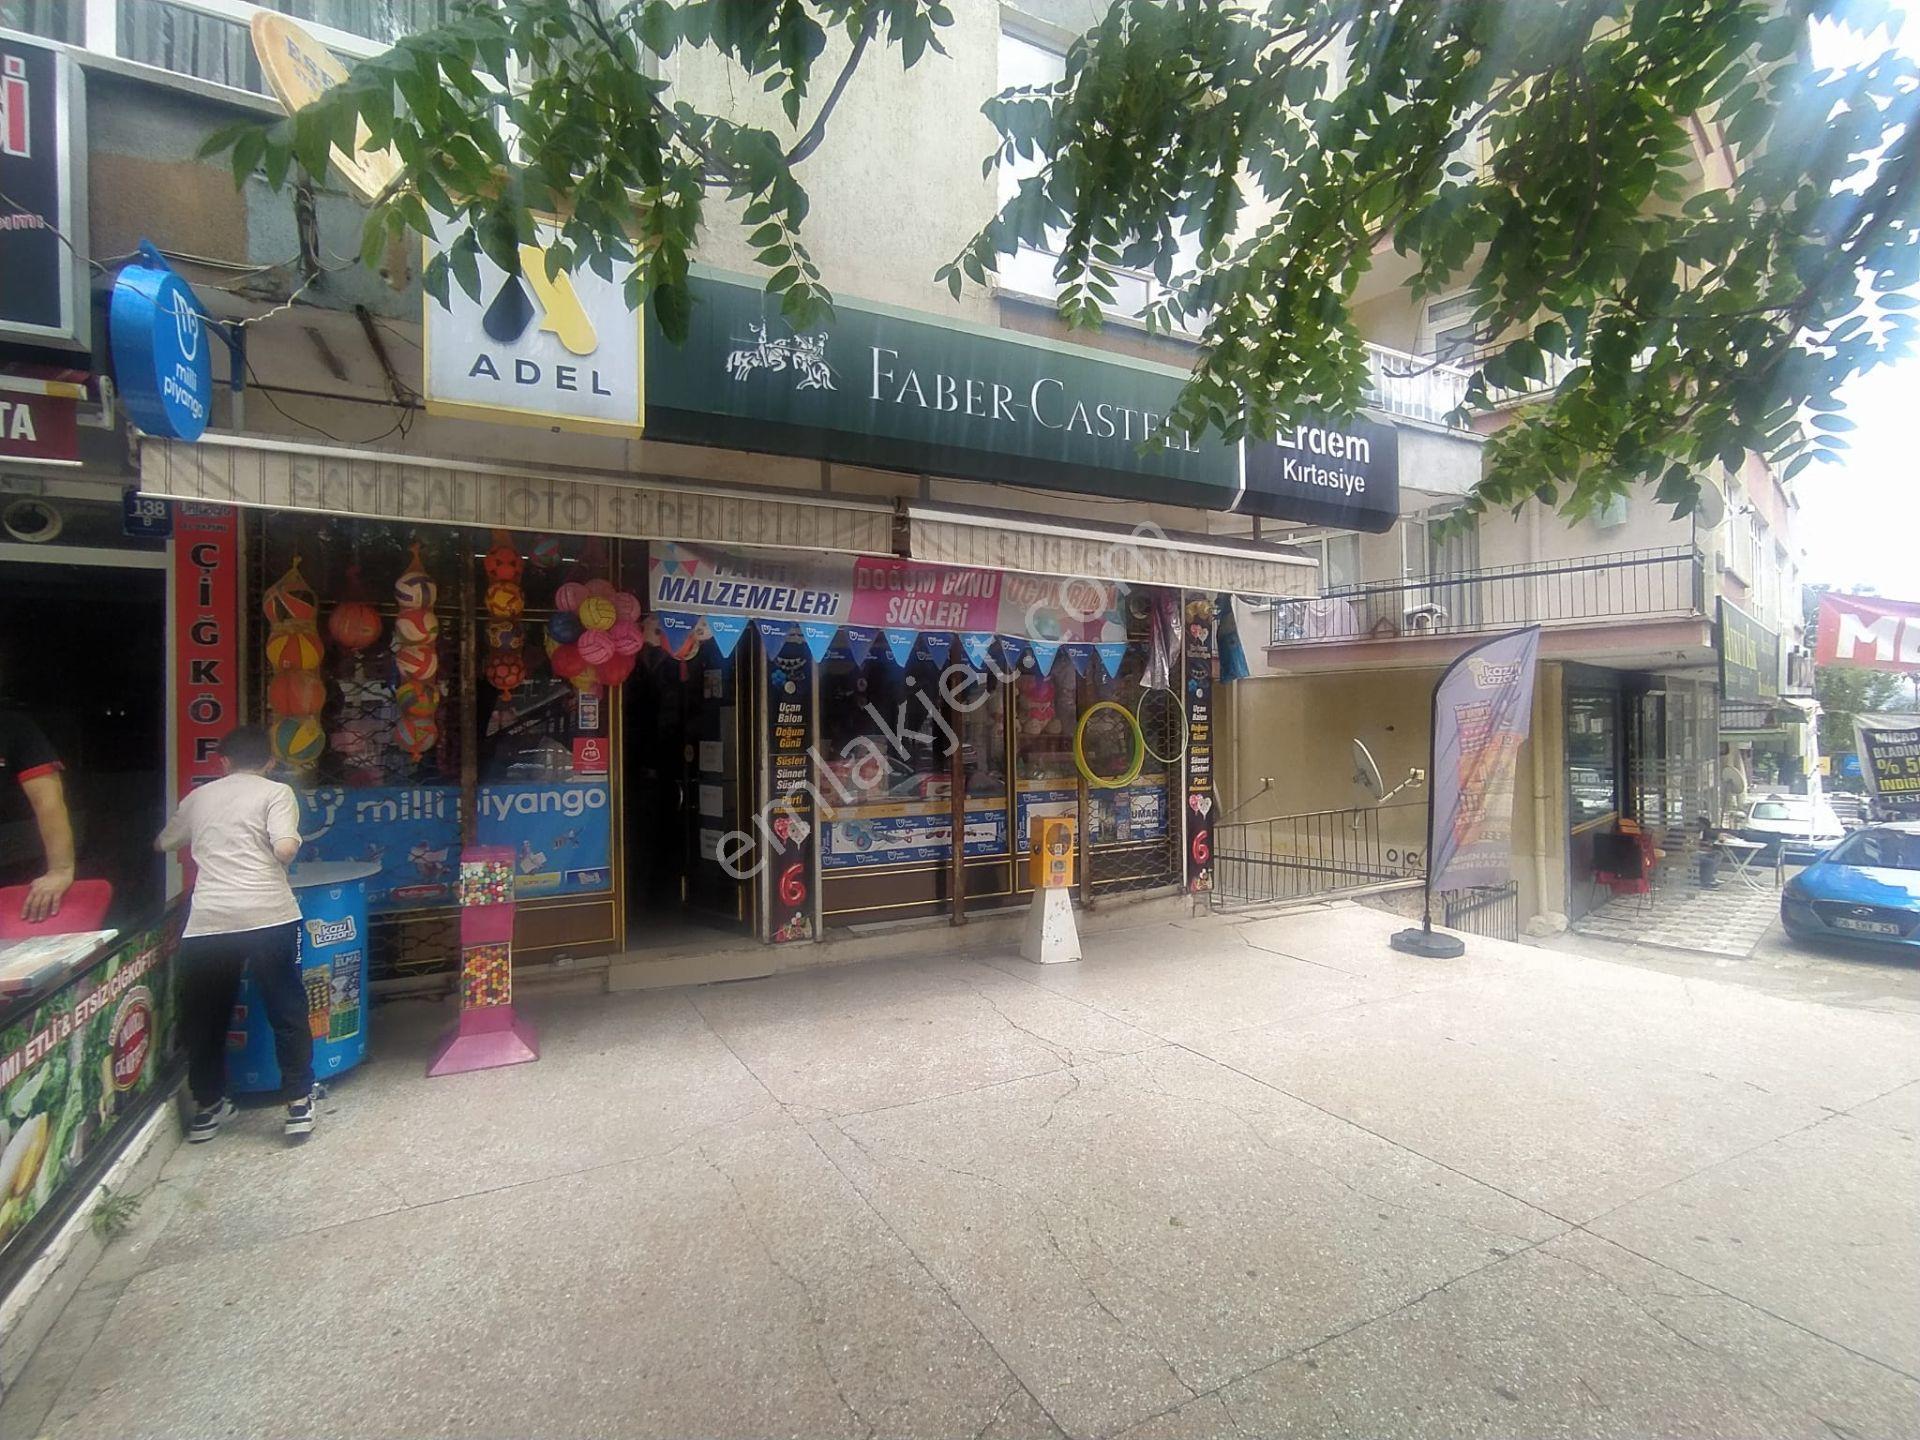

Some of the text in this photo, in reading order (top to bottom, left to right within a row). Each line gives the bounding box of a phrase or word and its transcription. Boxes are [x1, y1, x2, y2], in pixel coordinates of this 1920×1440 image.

[176, 362, 197, 392] milli
[468, 353, 611, 396] ADEL
[164, 376, 204, 419] piyango
[1283, 457, 1366, 497] Kırtasiye
[134, 500, 166, 516] 138
[941, 569, 997, 601] GÜNÜ
[188, 543, 222, 787] ÇİĞKÖF
[778, 713, 803, 723] Balon
[779, 702, 802, 714] Uçan
[776, 726, 805, 738] Doğum
[1873, 743, 1920, 759] BLADİN
[1879, 774, 1920, 791] İNDİR
[356, 790, 444, 823] milli
